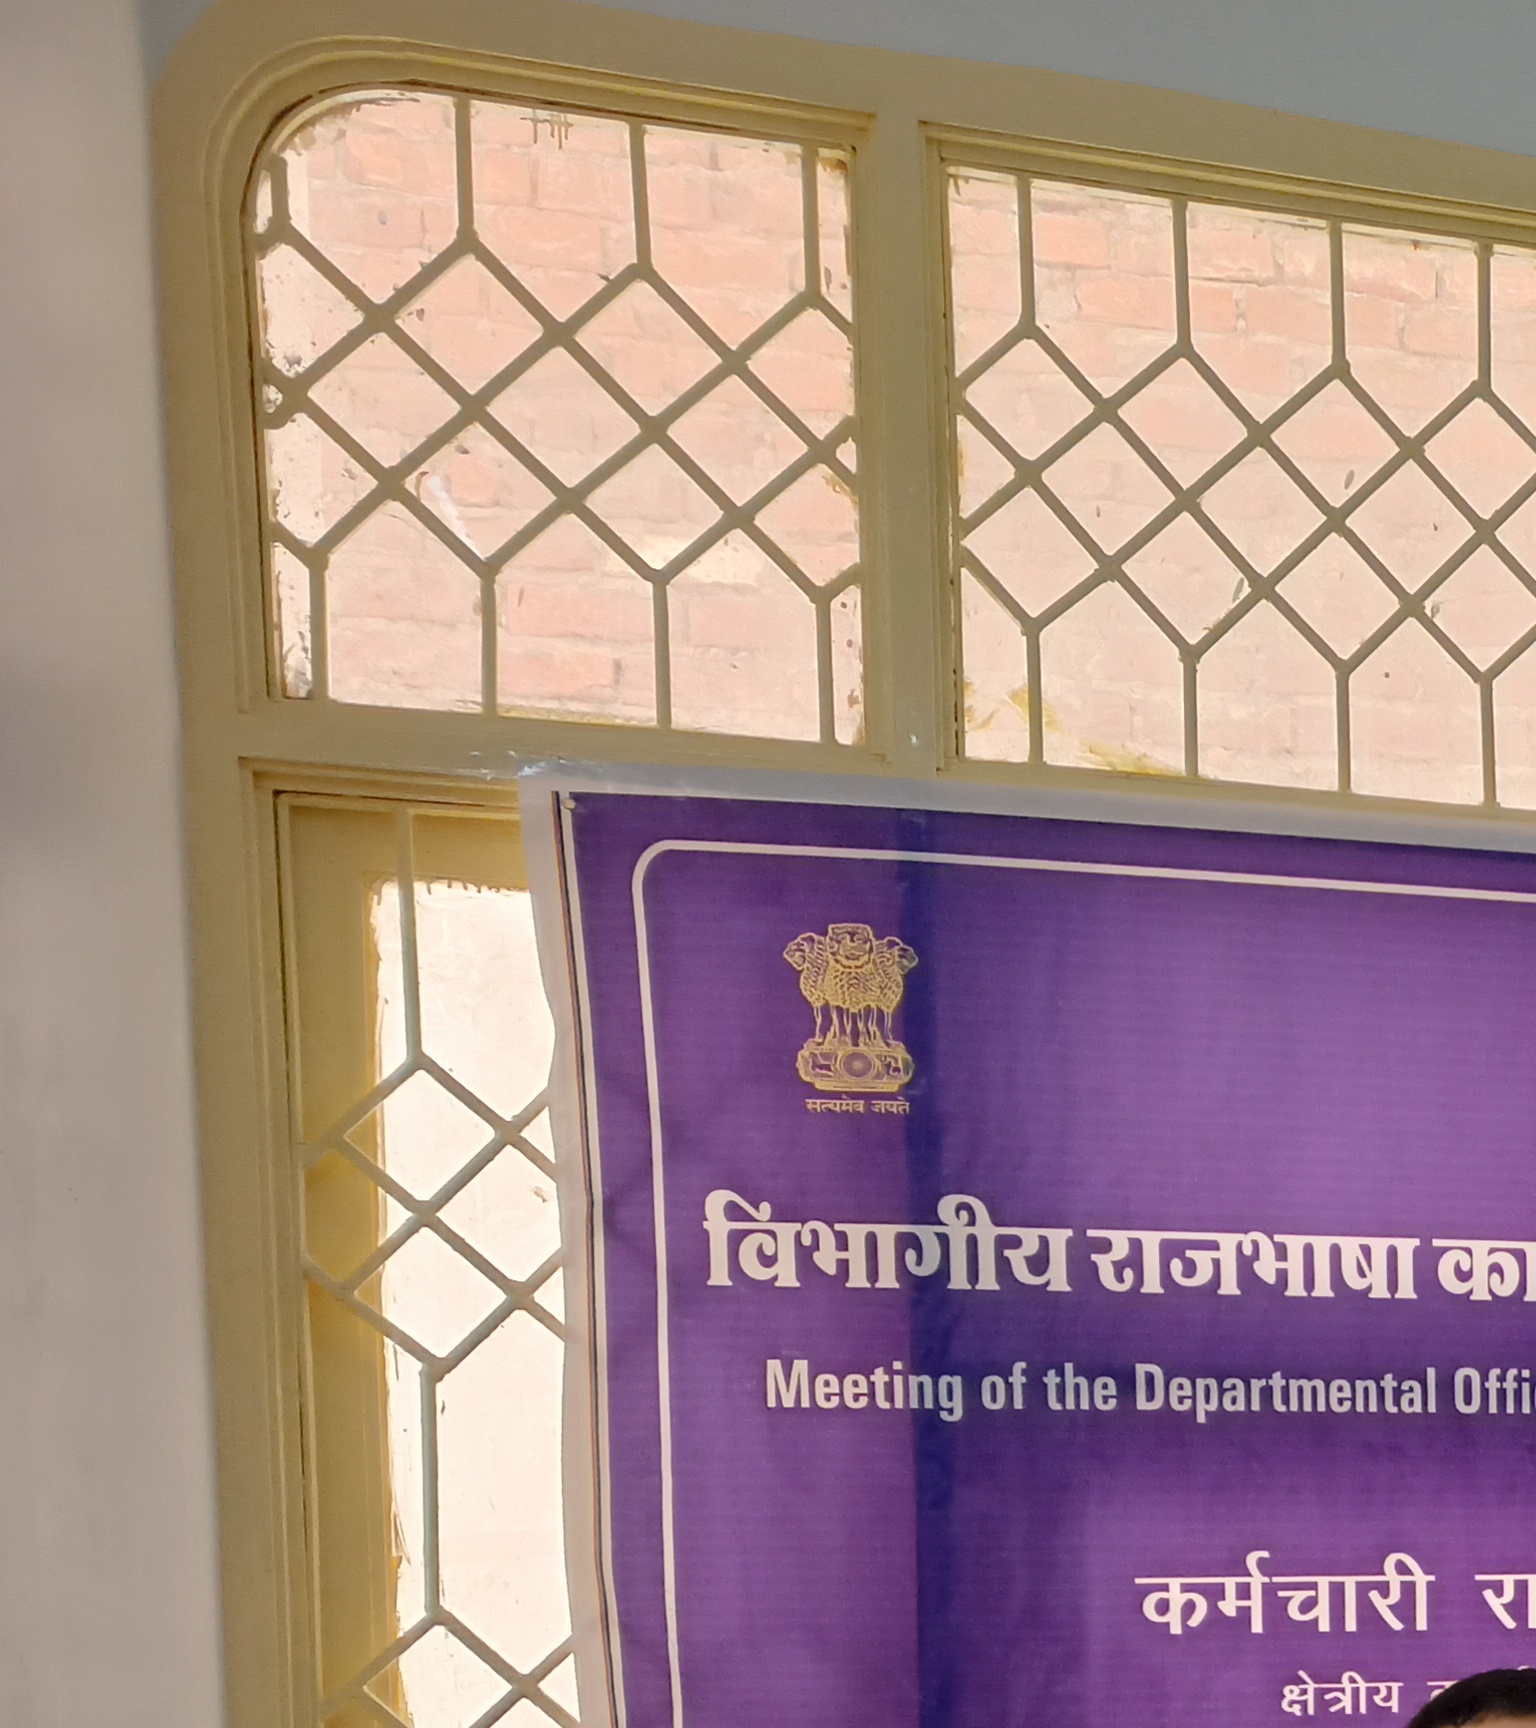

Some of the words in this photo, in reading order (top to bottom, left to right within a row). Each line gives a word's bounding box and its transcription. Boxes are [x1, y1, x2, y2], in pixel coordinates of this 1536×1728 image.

[703, 1190, 1073, 1291] विभागीय
[1087, 1230, 1420, 1298] राजभाषा
[767, 1359, 962, 1421] Meeting
[982, 1362, 1026, 1409] of
[1043, 1363, 1117, 1410] the
[1136, 1364, 1436, 1423] Departmental
[1135, 1551, 1435, 1634] कर्मचारी
[1282, 1670, 1403, 1716] क्षेत्रीय
